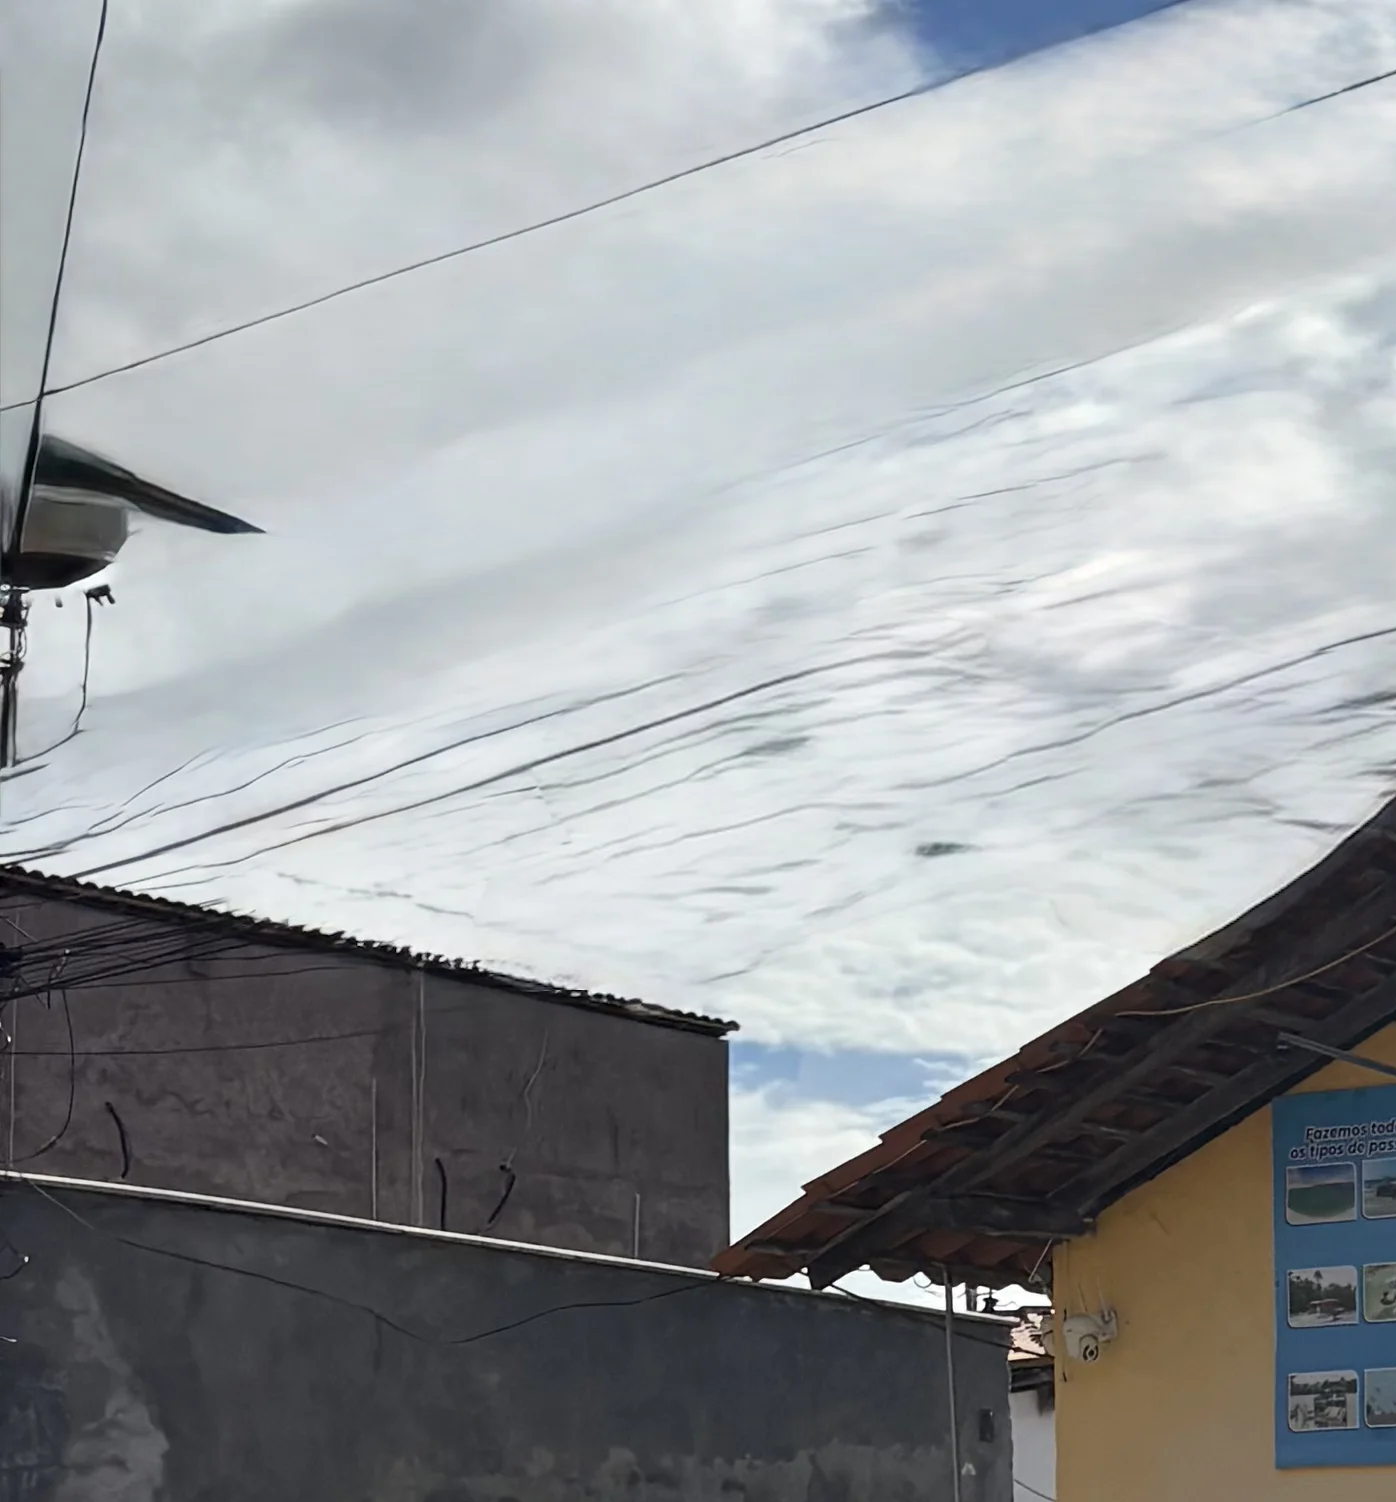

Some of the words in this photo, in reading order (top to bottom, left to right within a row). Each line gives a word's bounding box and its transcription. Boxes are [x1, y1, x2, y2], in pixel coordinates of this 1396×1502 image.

[1305, 1121, 1368, 1142] Fazemos
[1309, 1139, 1344, 1160] tipos
[1347, 1140, 1365, 1155] de
